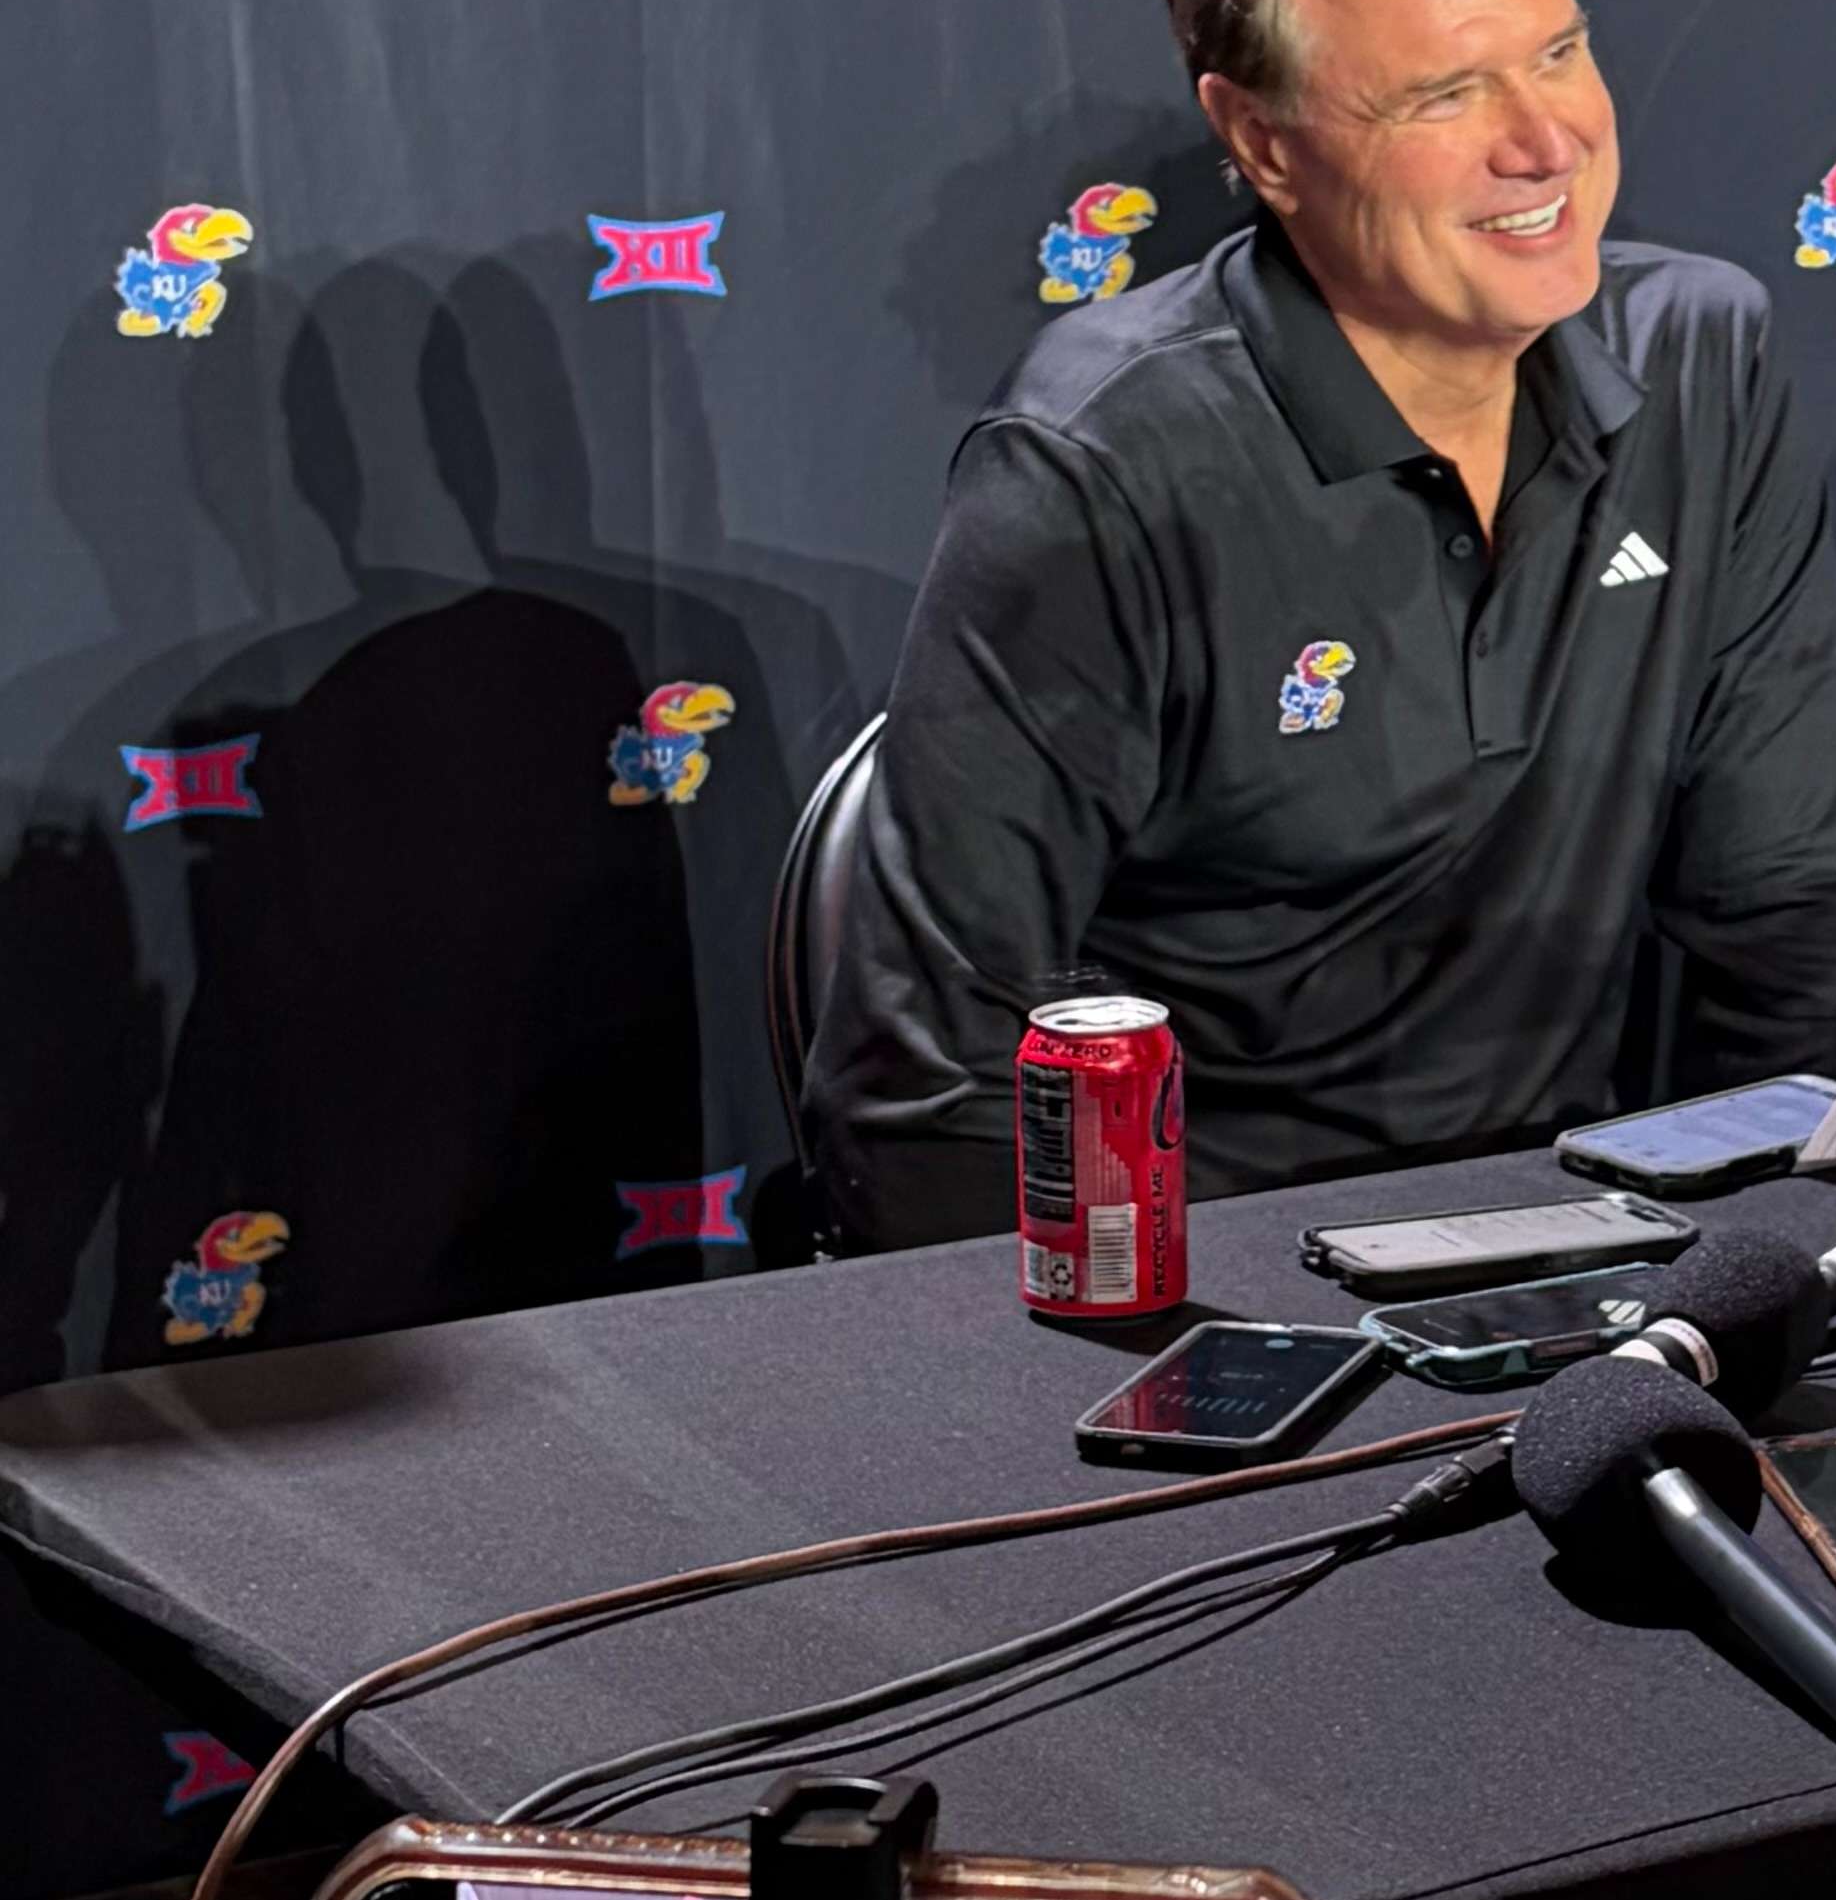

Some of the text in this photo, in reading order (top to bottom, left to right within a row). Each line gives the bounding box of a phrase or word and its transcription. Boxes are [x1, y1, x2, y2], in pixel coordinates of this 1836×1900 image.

[598, 220, 714, 292] XII
[1070, 245, 1102, 270] KU
[151, 274, 189, 301] KU
[131, 740, 254, 823] XII
